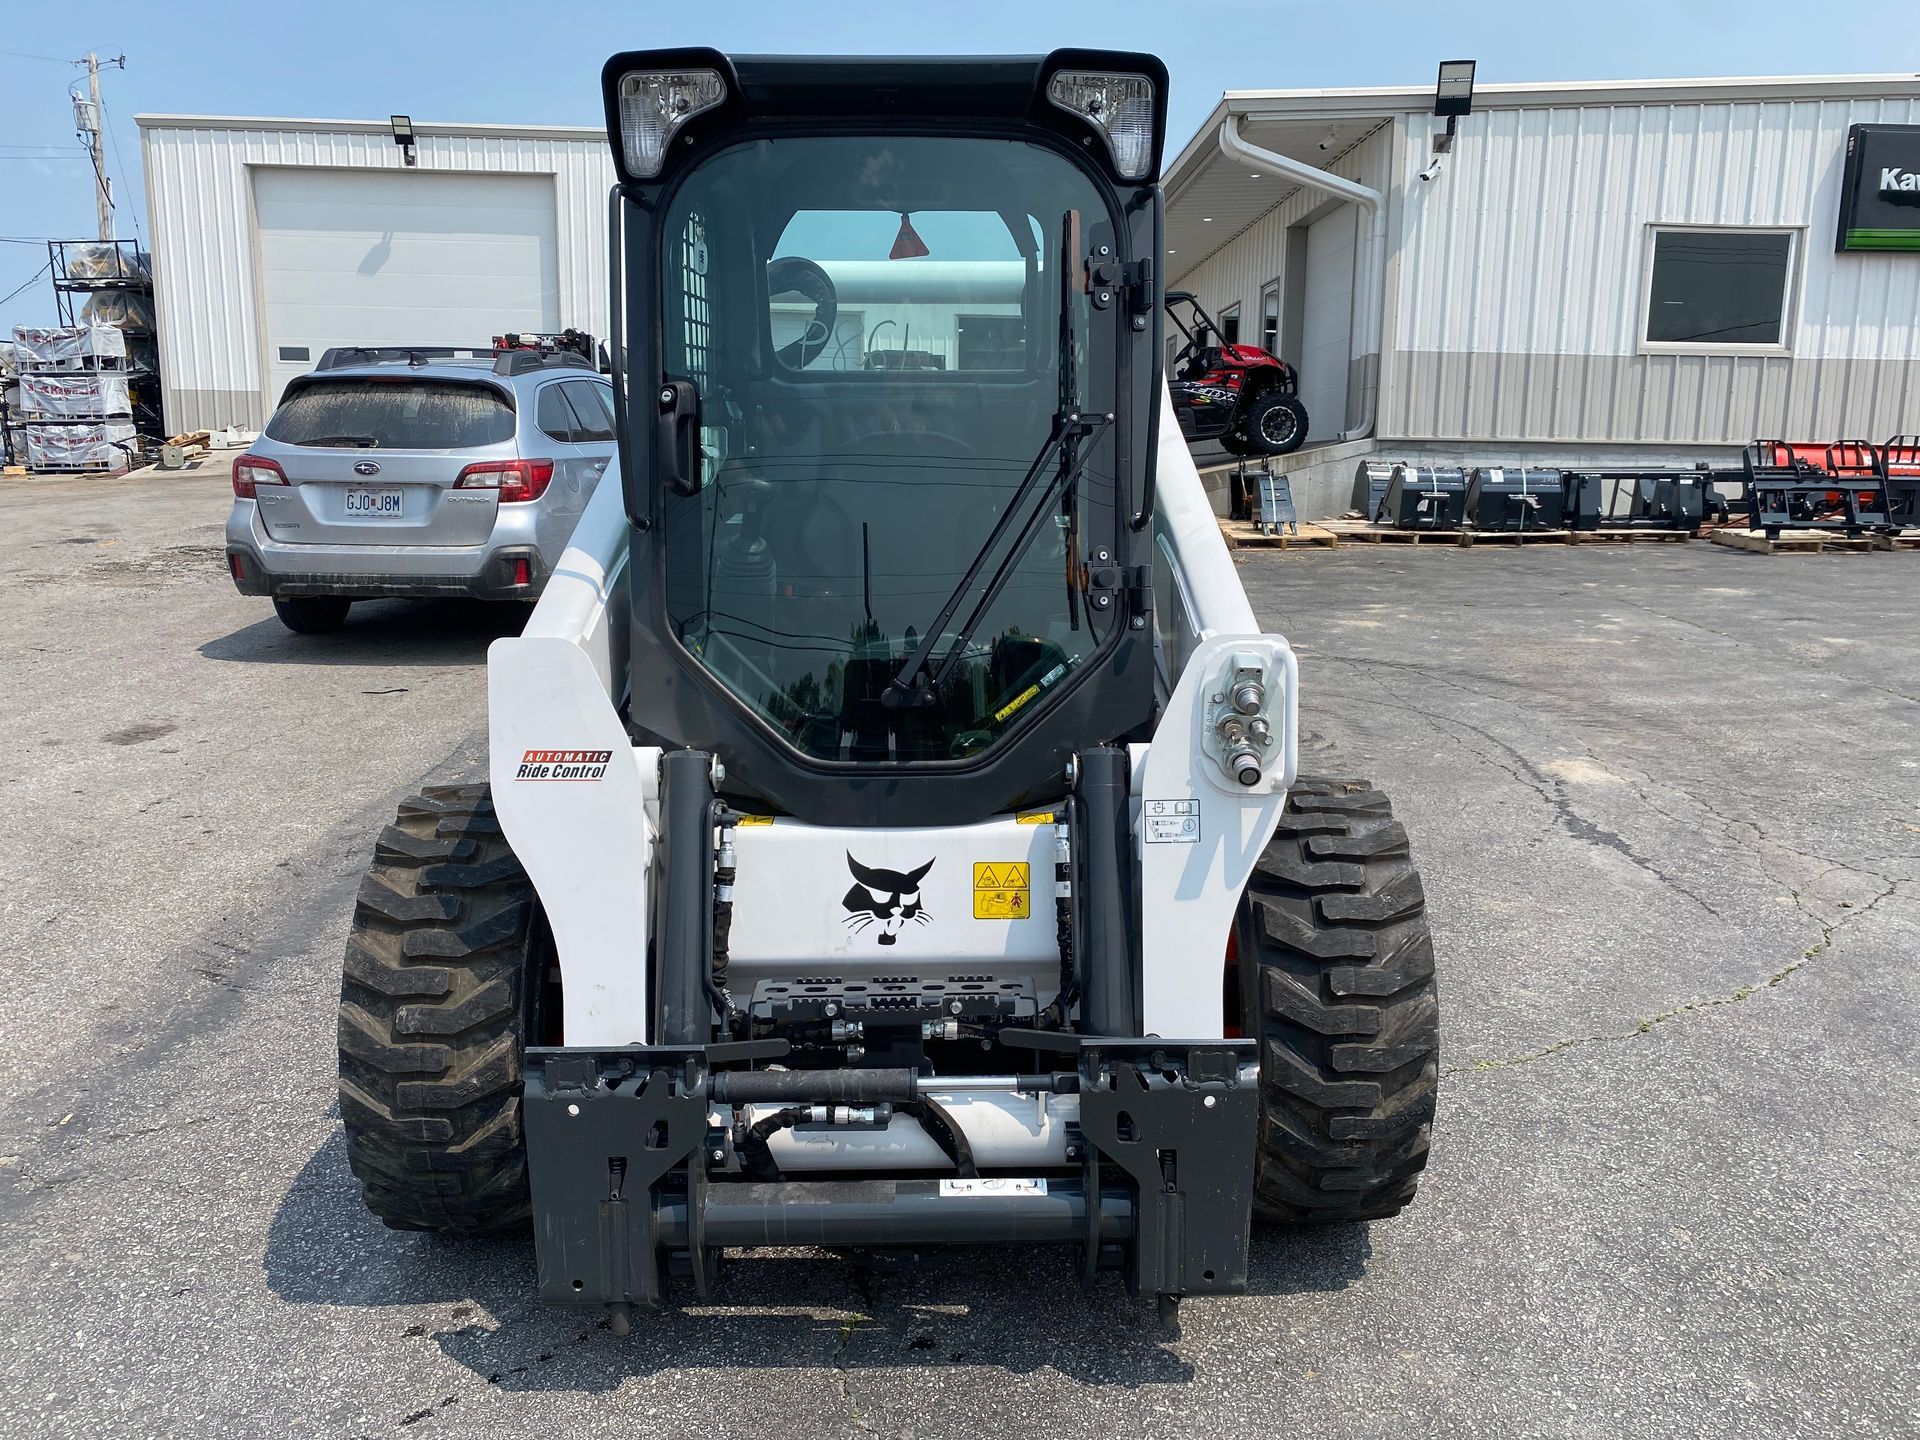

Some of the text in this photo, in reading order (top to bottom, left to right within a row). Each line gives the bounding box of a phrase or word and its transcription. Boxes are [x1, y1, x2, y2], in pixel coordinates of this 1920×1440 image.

[1880, 167, 1920, 191] Ka
[525, 752, 609, 762] AUTOMATIC
[516, 763, 607, 778] Ride Control
